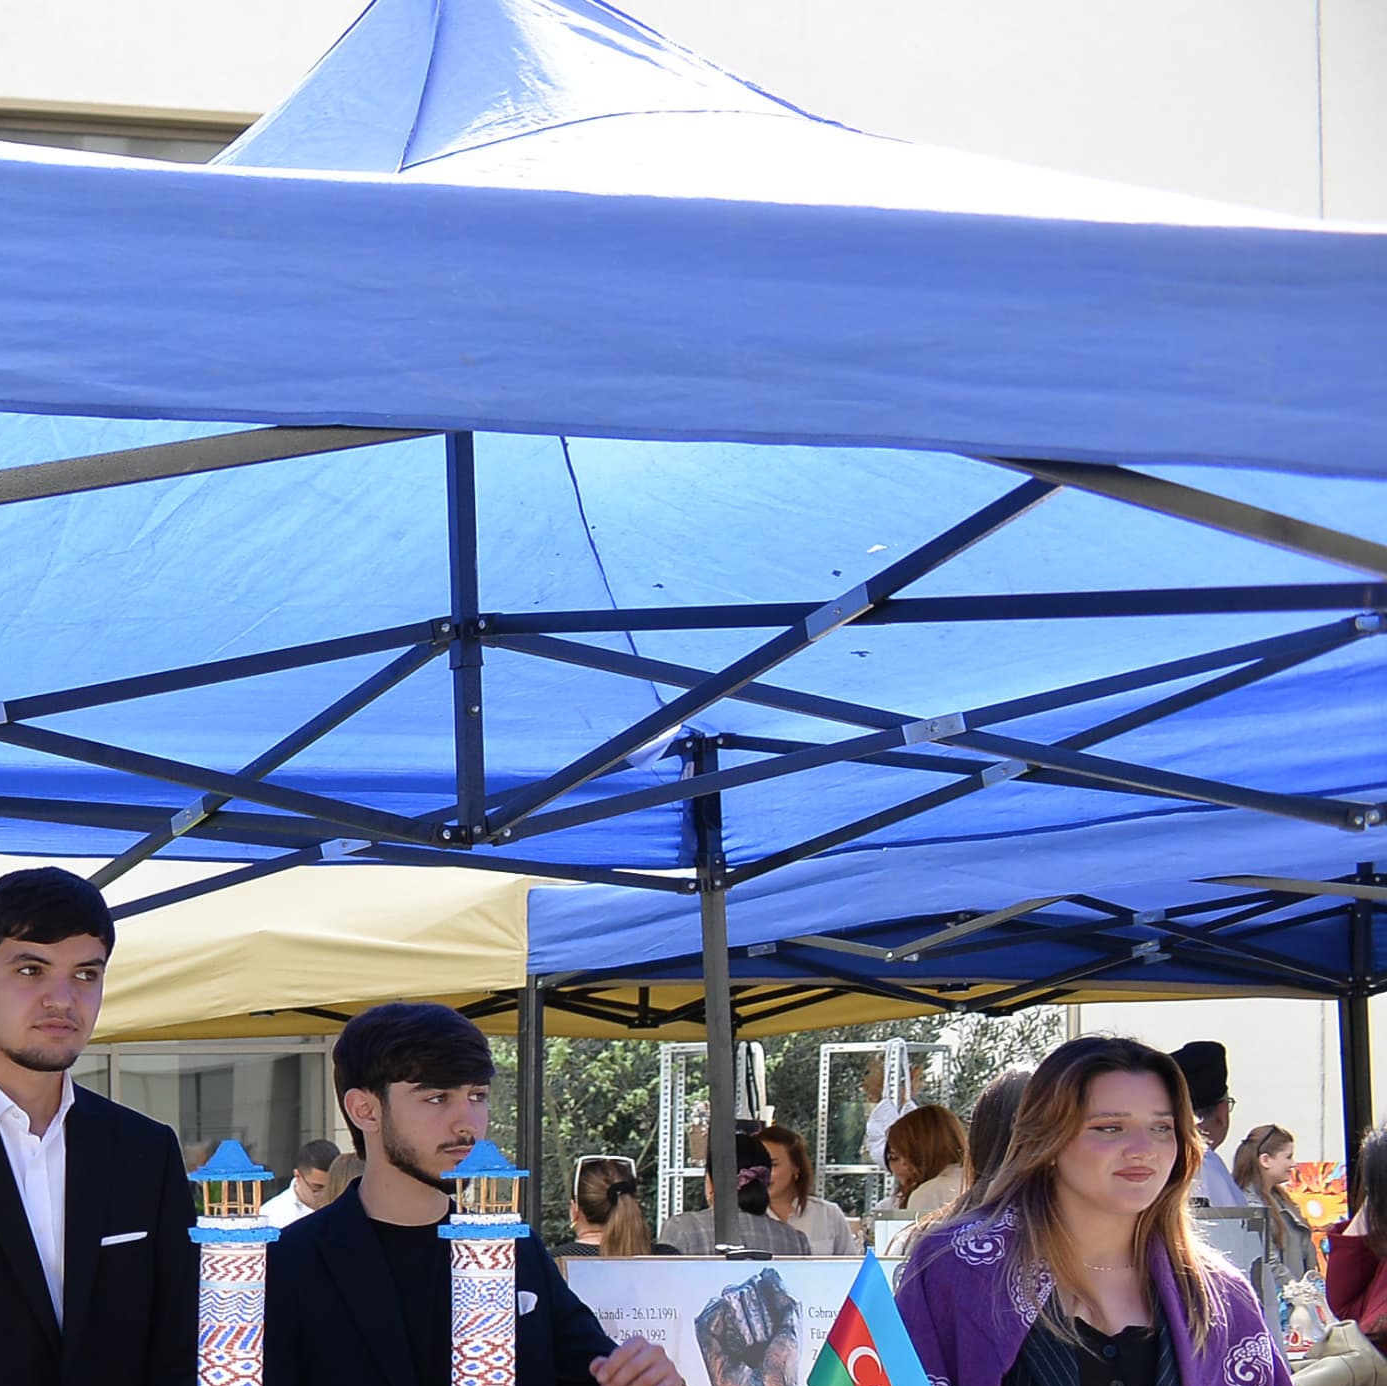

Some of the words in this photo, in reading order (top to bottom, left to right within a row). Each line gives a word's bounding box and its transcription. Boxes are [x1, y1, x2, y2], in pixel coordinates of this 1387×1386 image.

[632, 1307, 677, 1320] 26.12.1991
[808, 1306, 837, 1320] Cəbray
[810, 1328, 827, 1340] Füz
